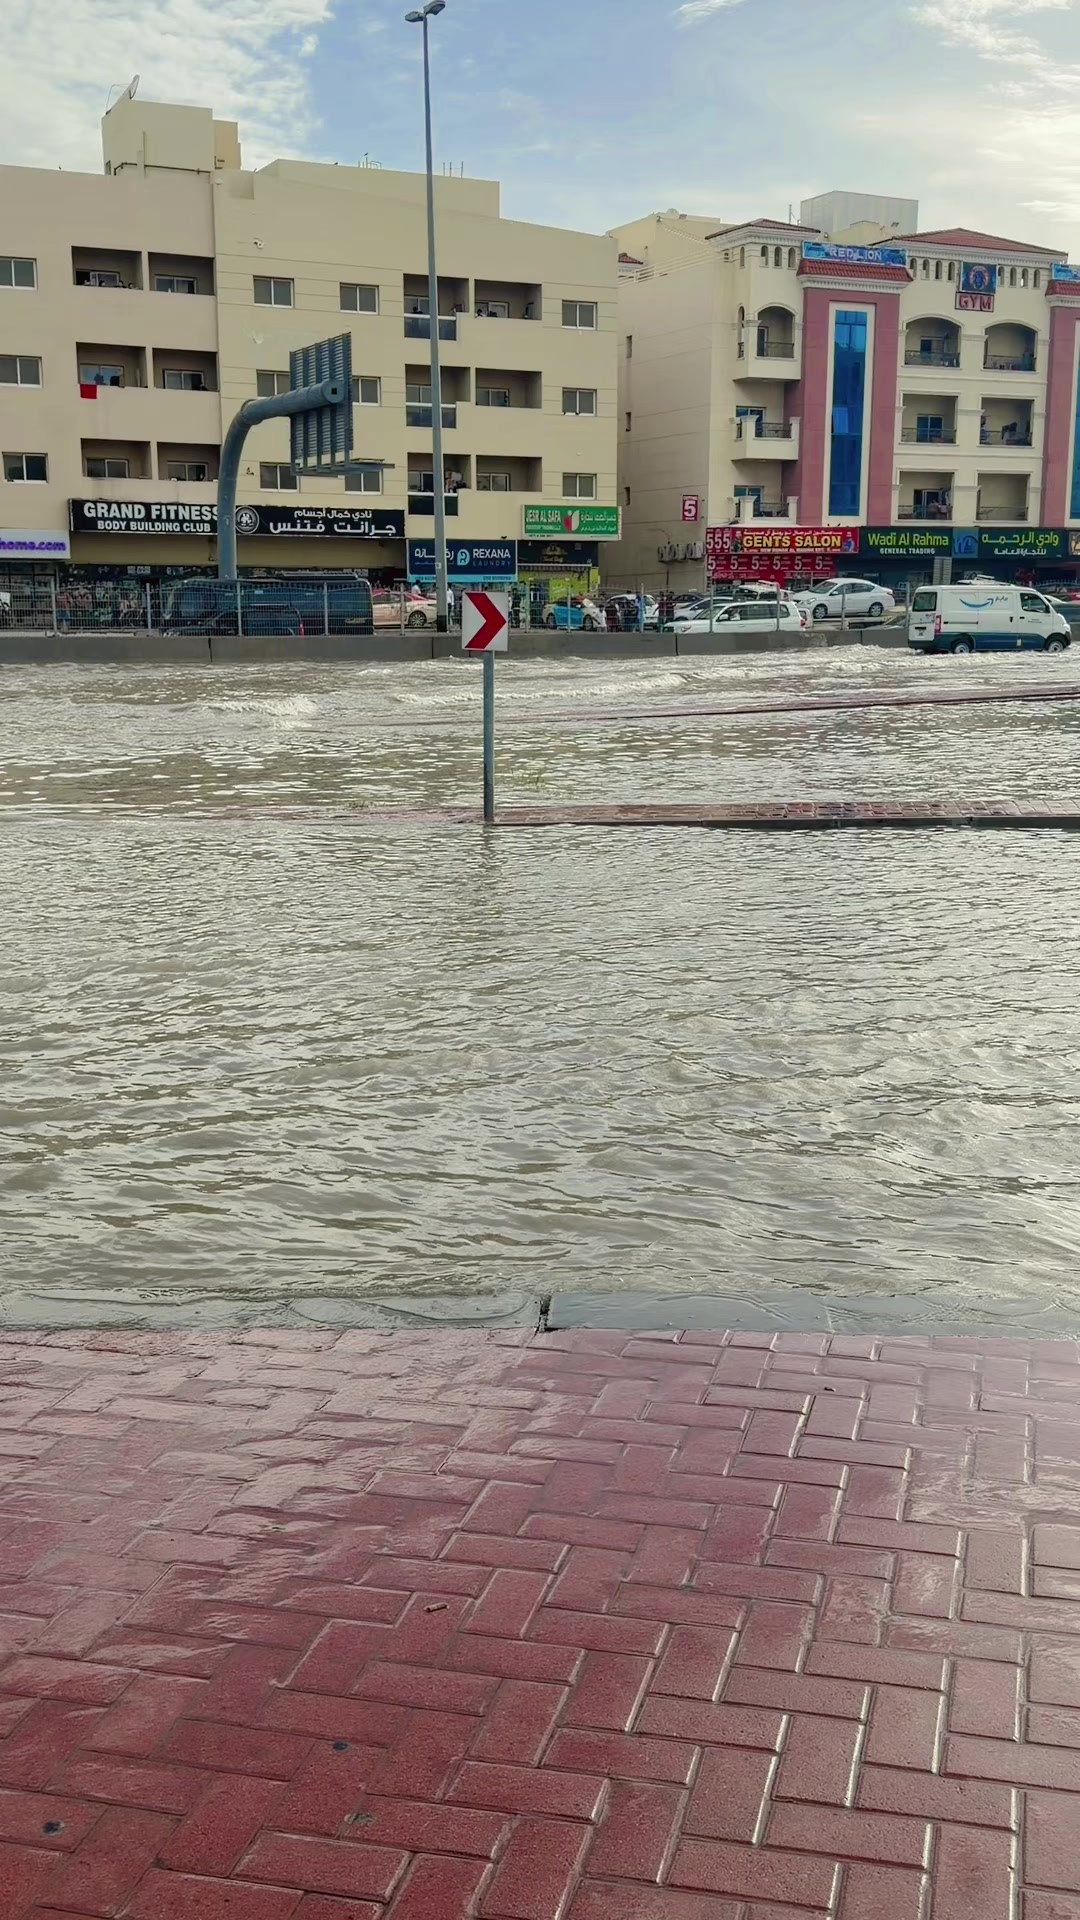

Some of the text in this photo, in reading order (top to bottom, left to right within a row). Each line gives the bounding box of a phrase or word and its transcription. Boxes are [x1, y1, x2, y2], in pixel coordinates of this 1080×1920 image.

[829, 247, 882, 261] RED LION
[959, 294, 992, 311] GYM
[83, 502, 146, 519] GRAND
[548, 510, 561, 523] SAFA
[97, 520, 211, 532] BODY BUILDING CLUB
[743, 535, 842, 548] GENTS SALON
[868, 531, 949, 546] Wadi Al Rahma
[1036, 531, 1059, 546] وادي
[473, 548, 511, 559] REXANA
[880, 547, 907, 555] GENERAL
